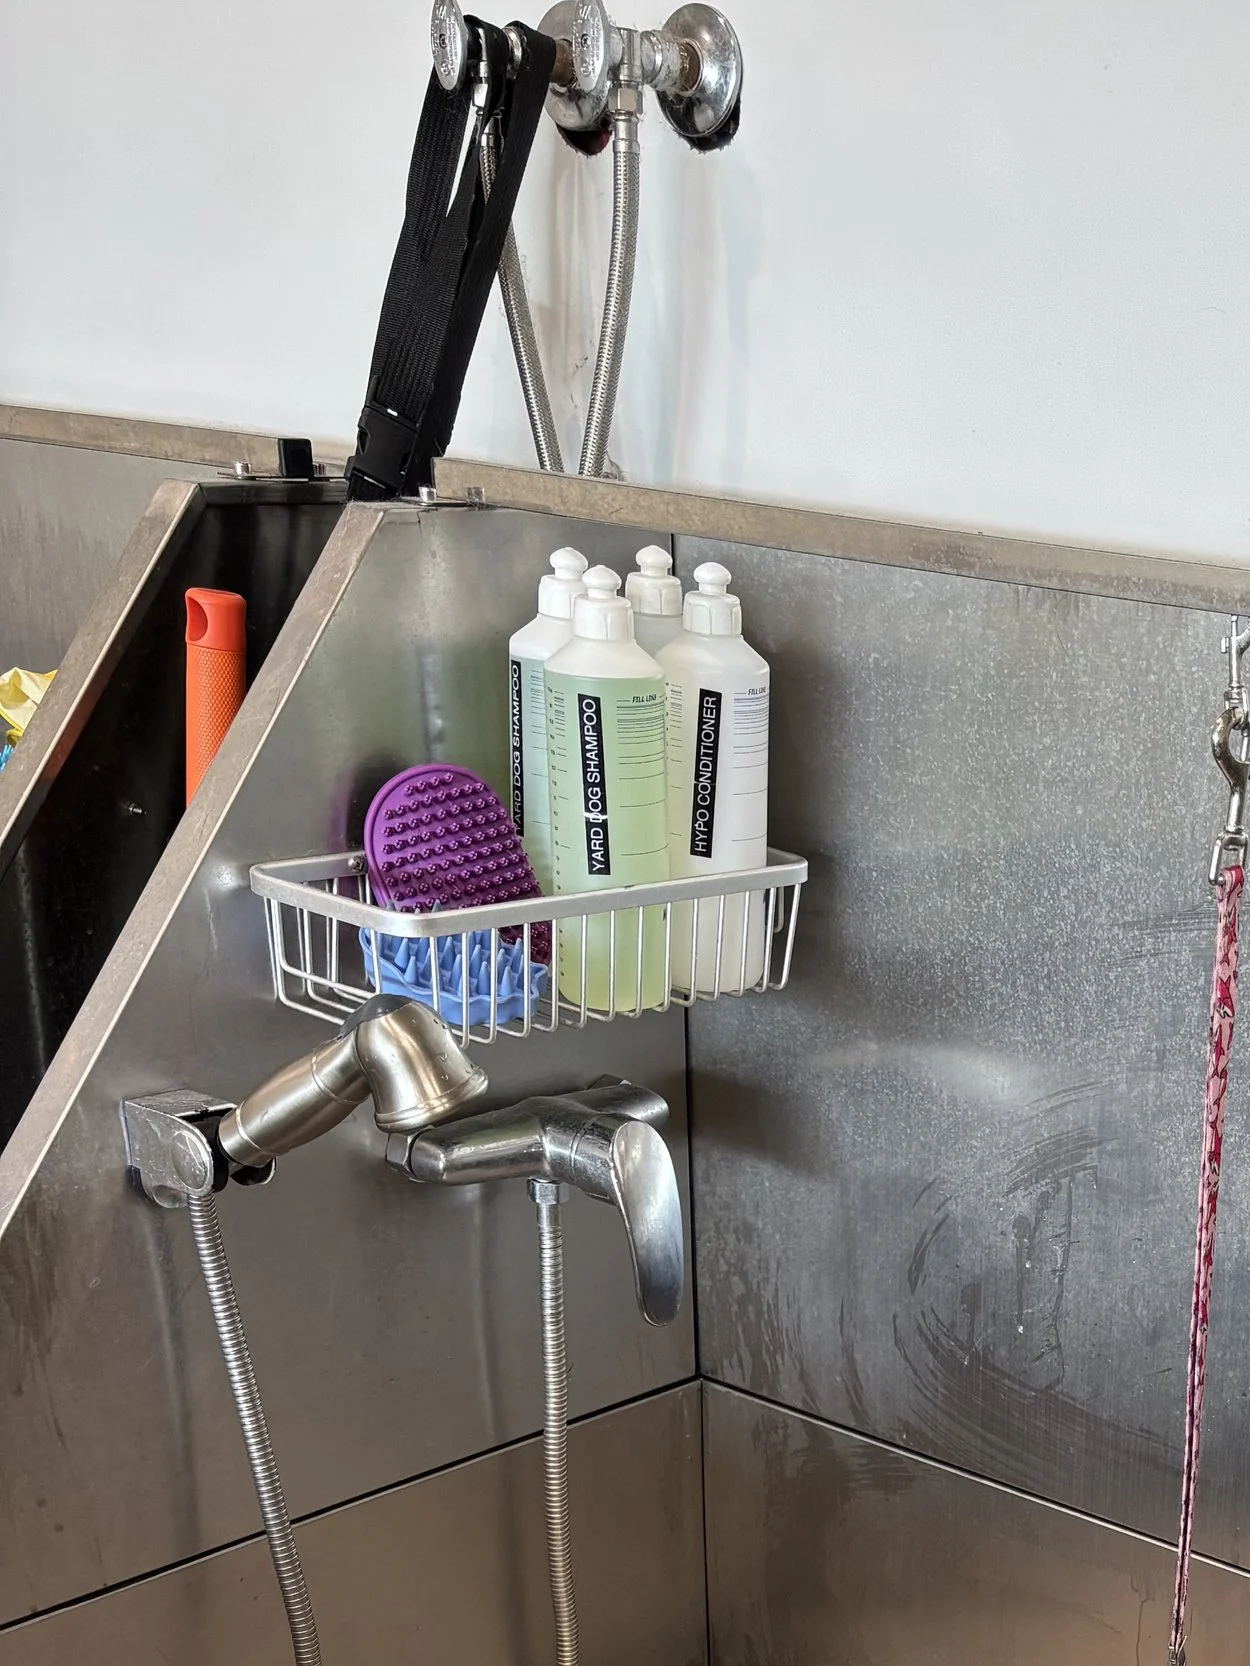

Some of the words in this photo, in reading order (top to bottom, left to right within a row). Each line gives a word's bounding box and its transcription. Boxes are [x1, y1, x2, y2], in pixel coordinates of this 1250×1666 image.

[512, 664, 521, 747] SHAMPOO
[582, 699, 601, 783] SHAMPOO
[697, 696, 717, 806] CONDITIONER
[513, 752, 521, 787] DOG
[587, 787, 603, 823] DOG
[590, 827, 605, 871] YARD
[694, 809, 710, 852] HYPO
